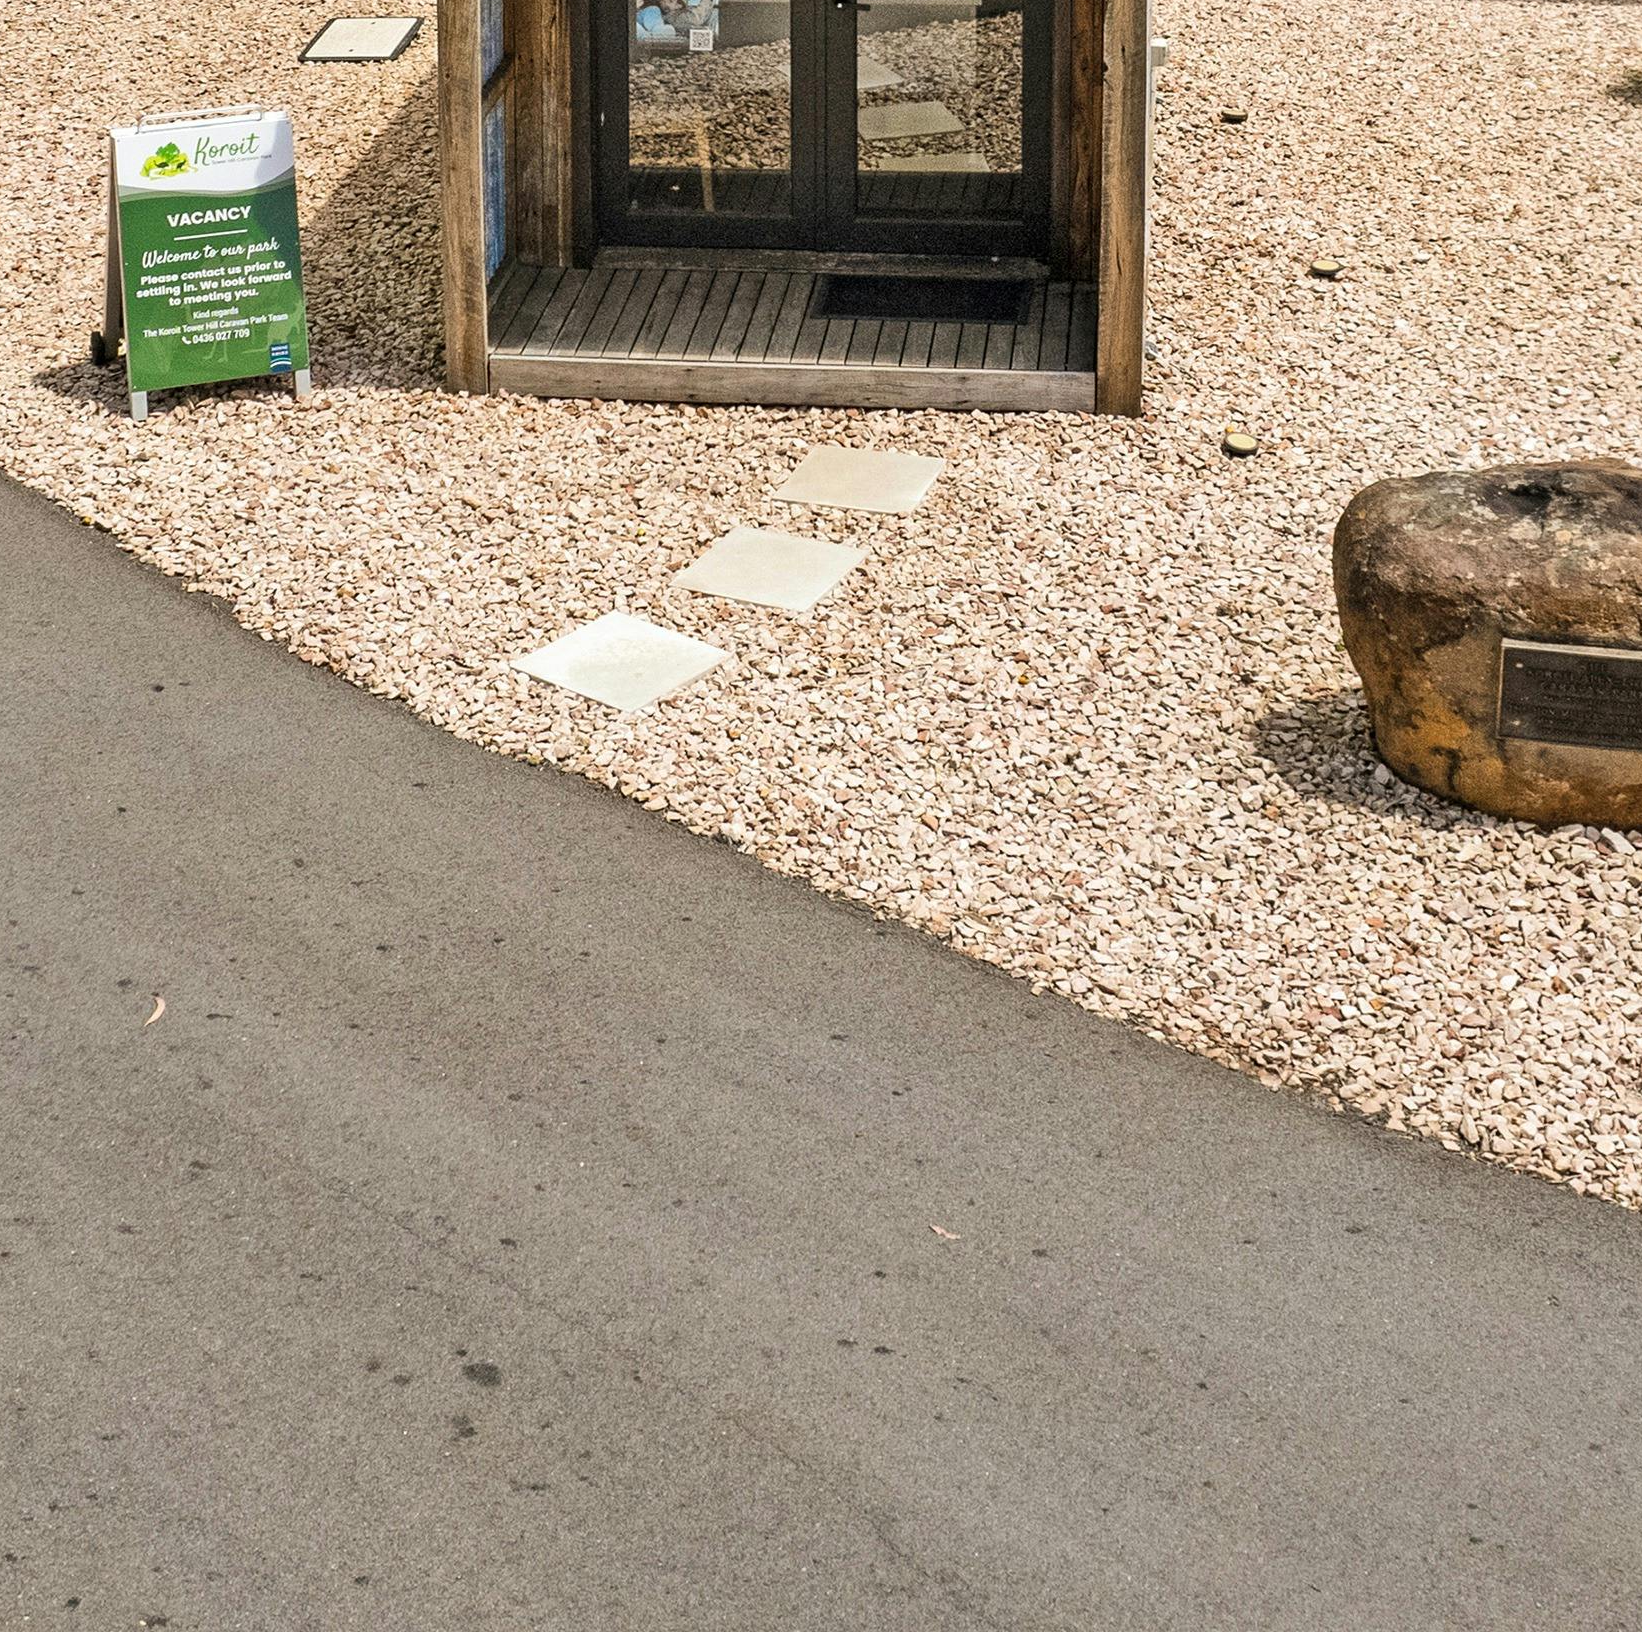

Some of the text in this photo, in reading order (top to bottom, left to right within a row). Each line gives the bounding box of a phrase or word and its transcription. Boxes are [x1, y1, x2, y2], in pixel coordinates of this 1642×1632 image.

[194, 133, 260, 166] Koroit
[167, 205, 251, 228] VACANCY
[142, 237, 280, 269] Welcome to our park
[136, 270, 292, 299] settling in. We look forward
[140, 260, 286, 286] Please contact us prior to
[169, 288, 259, 306] to meeting you.
[193, 306, 239, 319] Kind regards
[143, 313, 288, 338] The Koroit Tower Hill Caravan Park Team
[216, 330, 232, 341] 027
[234, 327, 251, 338] 709
